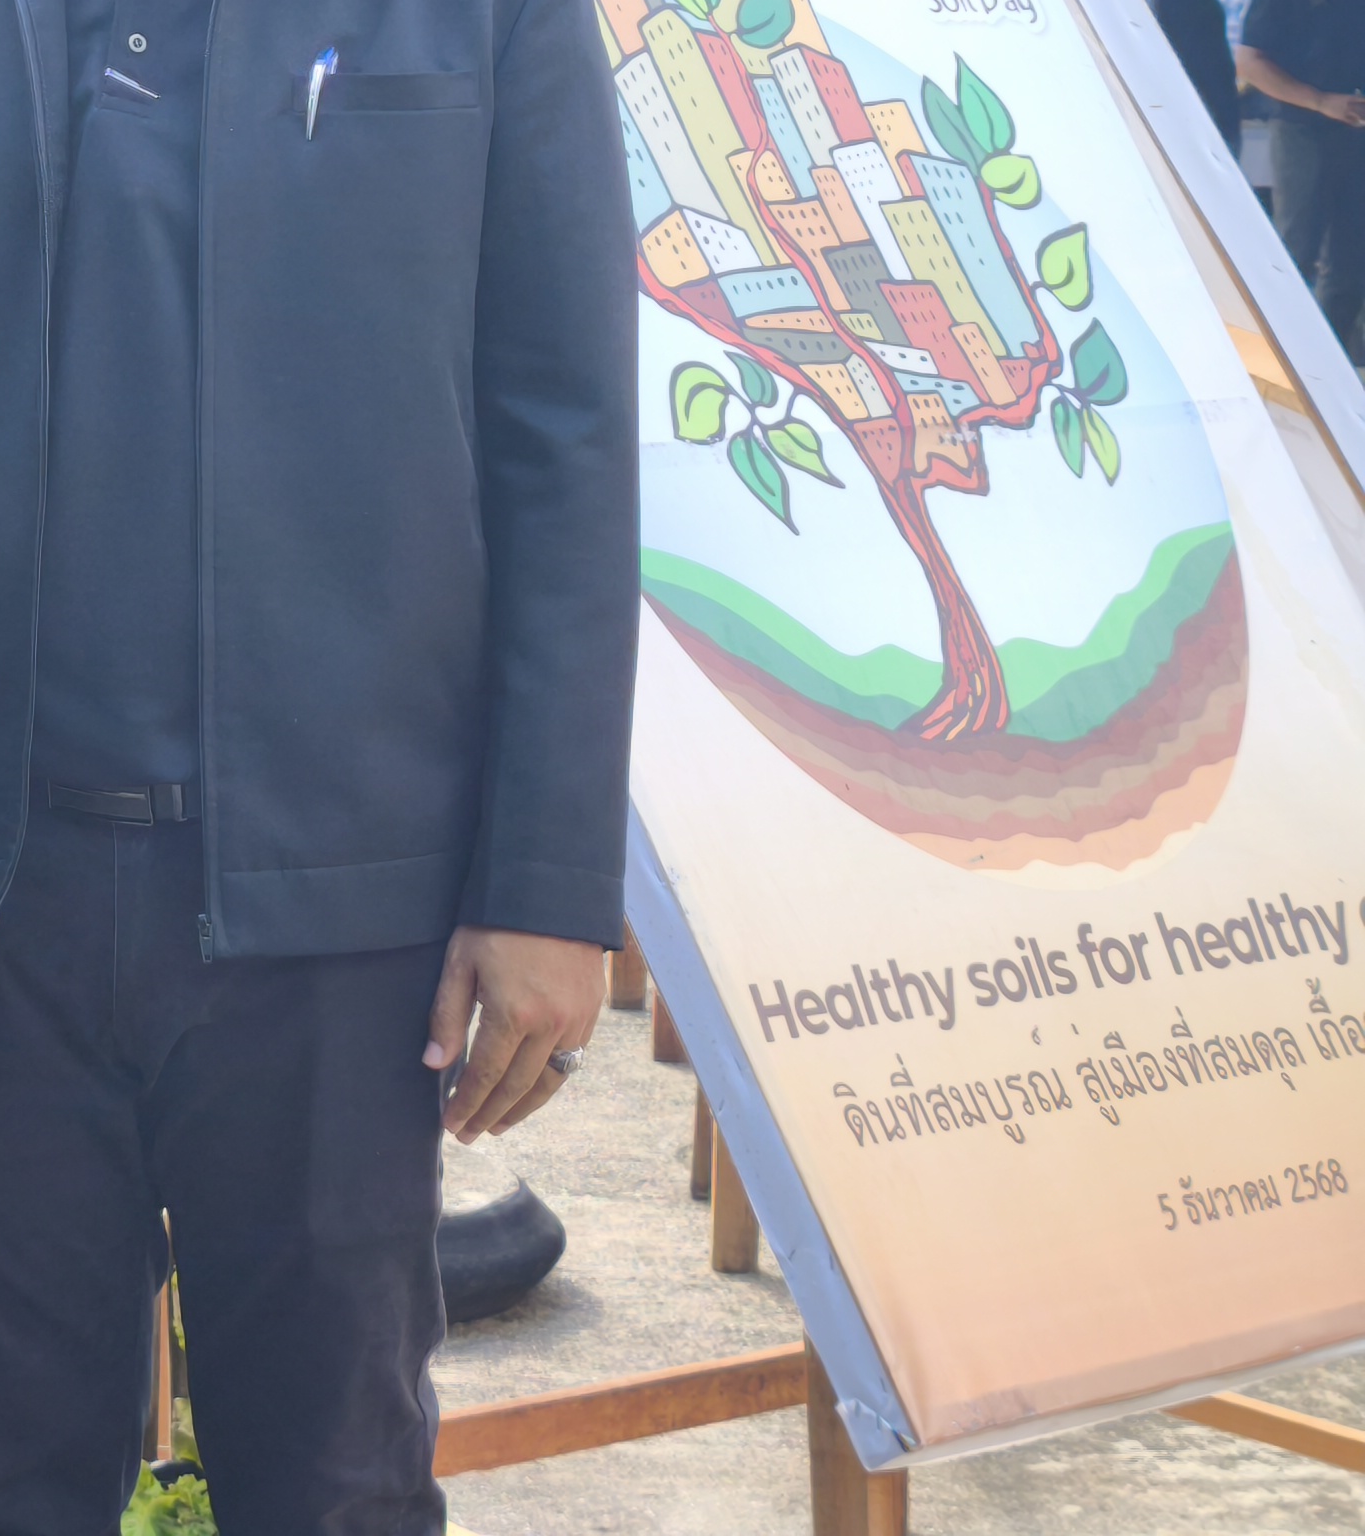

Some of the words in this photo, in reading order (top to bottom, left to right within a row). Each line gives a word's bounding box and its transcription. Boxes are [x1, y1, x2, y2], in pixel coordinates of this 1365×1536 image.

[749, 958, 955, 1042] Healthy
[967, 936, 1078, 1007] soils
[1076, 922, 1151, 988] for
[1154, 892, 1349, 975] healthy
[833, 1024, 1073, 1147] ดินที่สมบูรณ์
[1070, 1005, 1308, 1126] สู่เมืองที่สมดุล
[1304, 977, 1365, 1061] เกื้อ
[1157, 1193, 1178, 1231] 5
[1179, 1175, 1282, 1225] ธันวาคม
[1283, 1158, 1349, 1203] 2568
